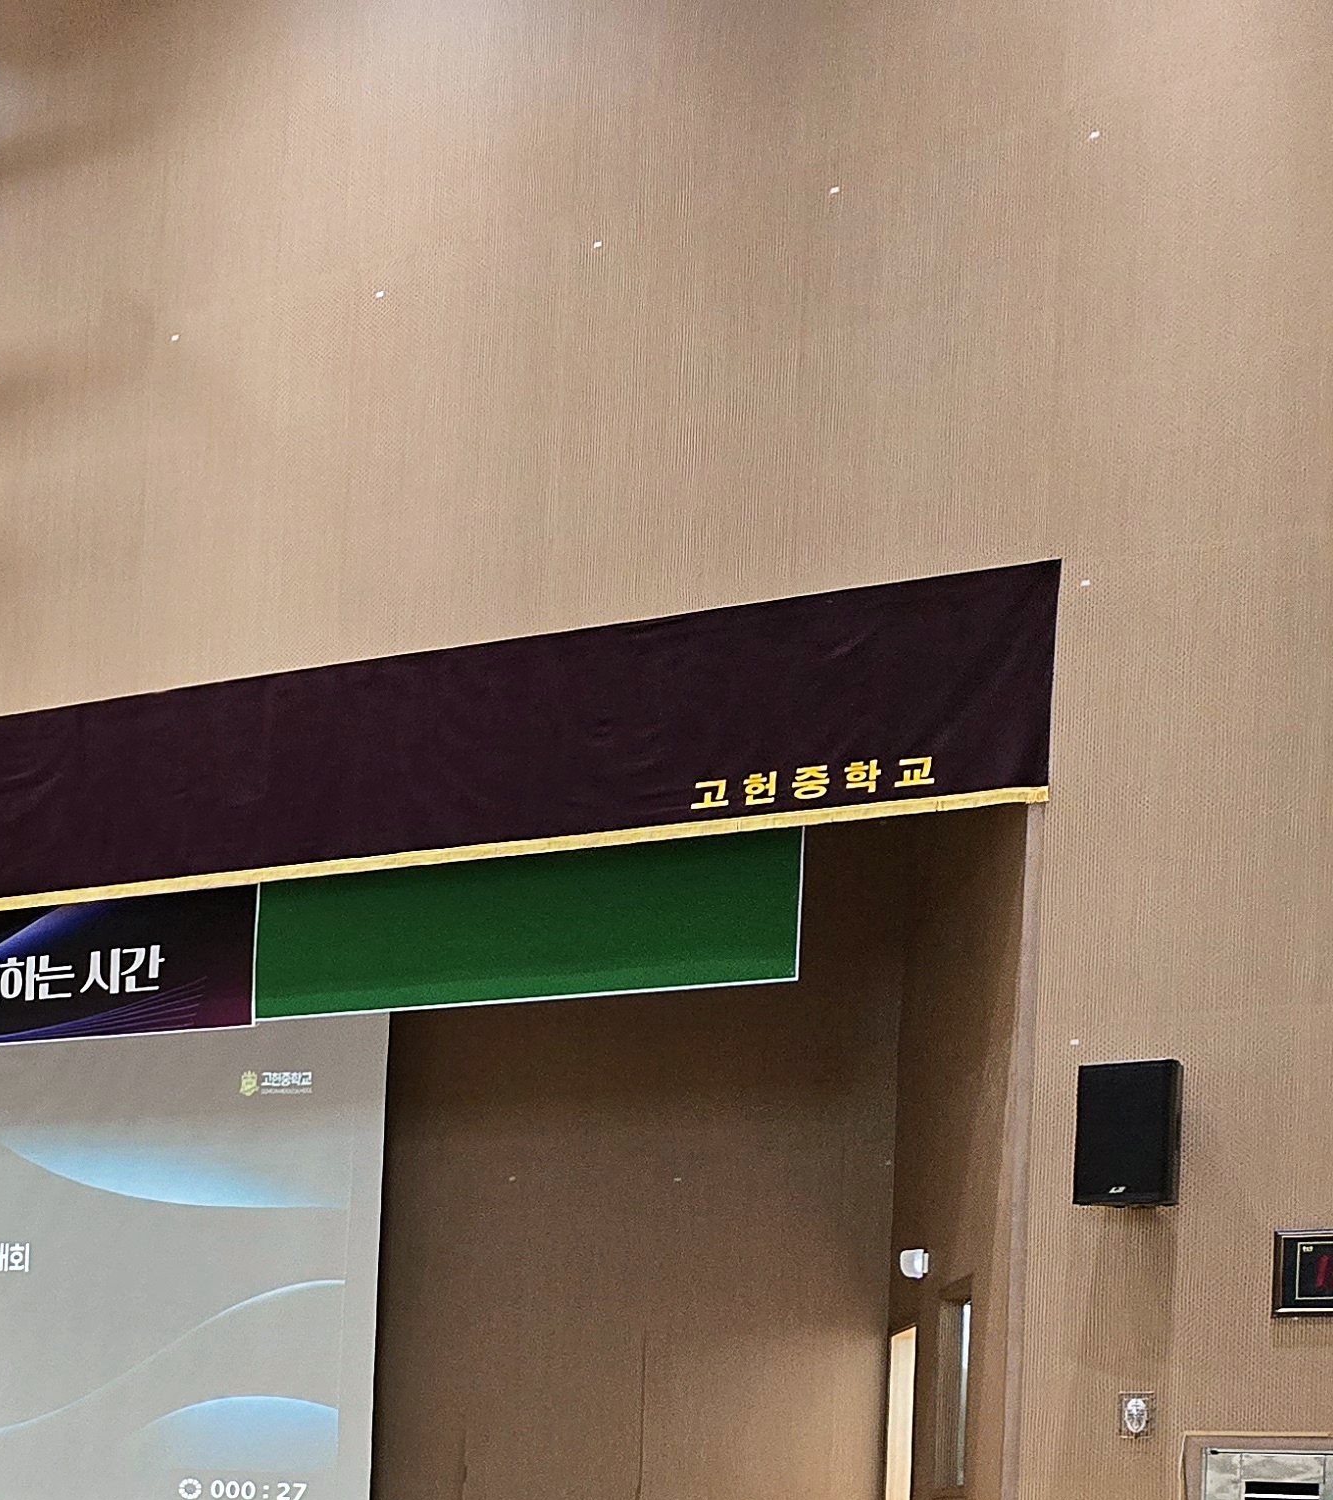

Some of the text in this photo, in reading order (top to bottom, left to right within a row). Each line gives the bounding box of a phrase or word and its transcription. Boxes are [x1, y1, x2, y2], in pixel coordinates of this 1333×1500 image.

[690, 756, 935, 810] 고헌중학교
[80, 944, 165, 995] 시간
[260, 1071, 312, 1087] 고헌중학교
